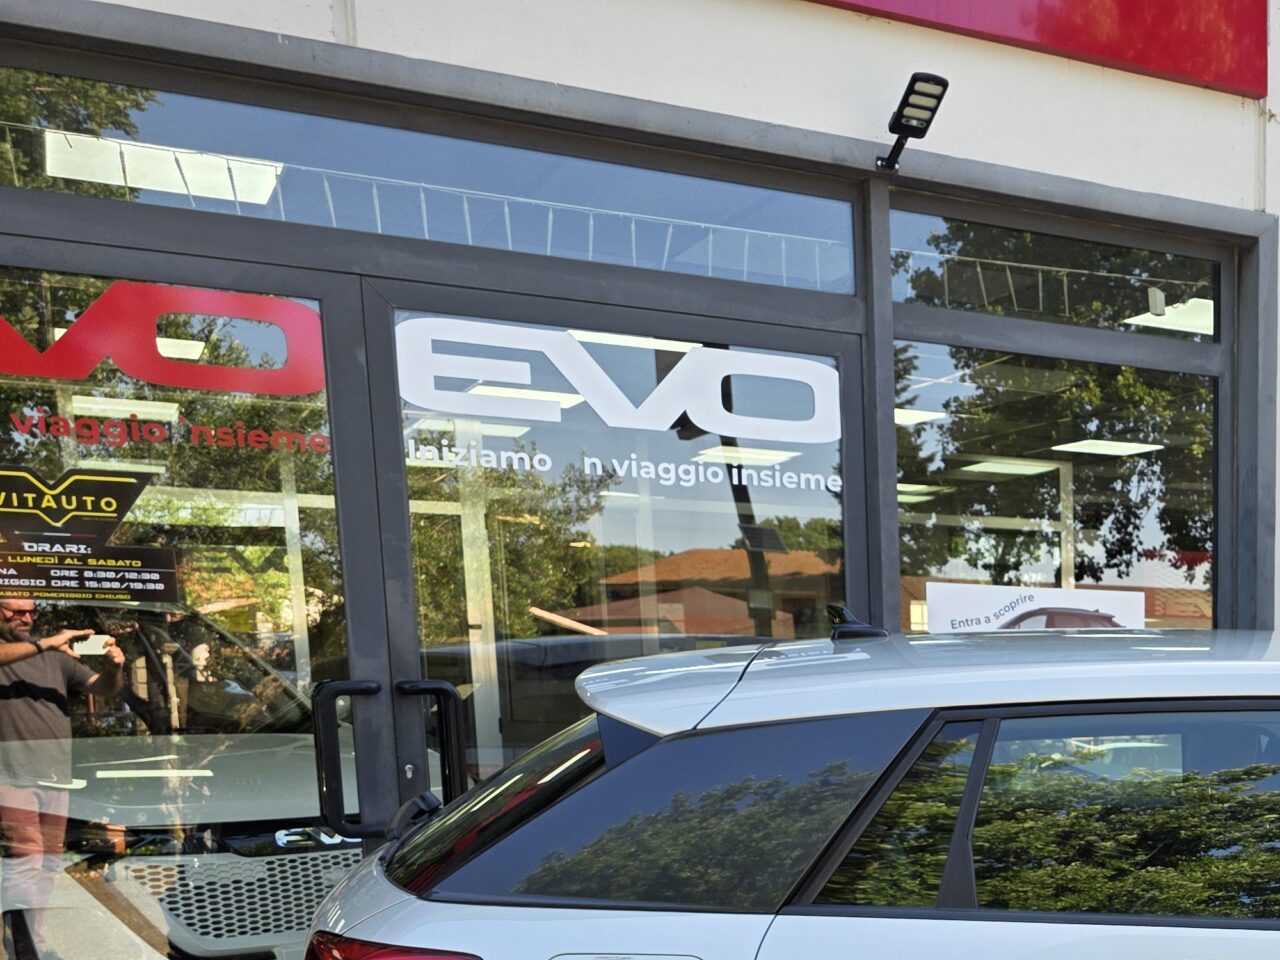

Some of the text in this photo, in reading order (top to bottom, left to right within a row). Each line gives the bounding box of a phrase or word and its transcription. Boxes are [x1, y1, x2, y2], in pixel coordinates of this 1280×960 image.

[0, 280, 326, 395] VO
[395, 317, 842, 443] EVO
[9, 406, 330, 453] viaggio nsieme
[408, 438, 843, 492] Iniziamo n viaggio insieme
[950, 618, 981, 630] Entra
[993, 594, 1035, 620] scoprire
